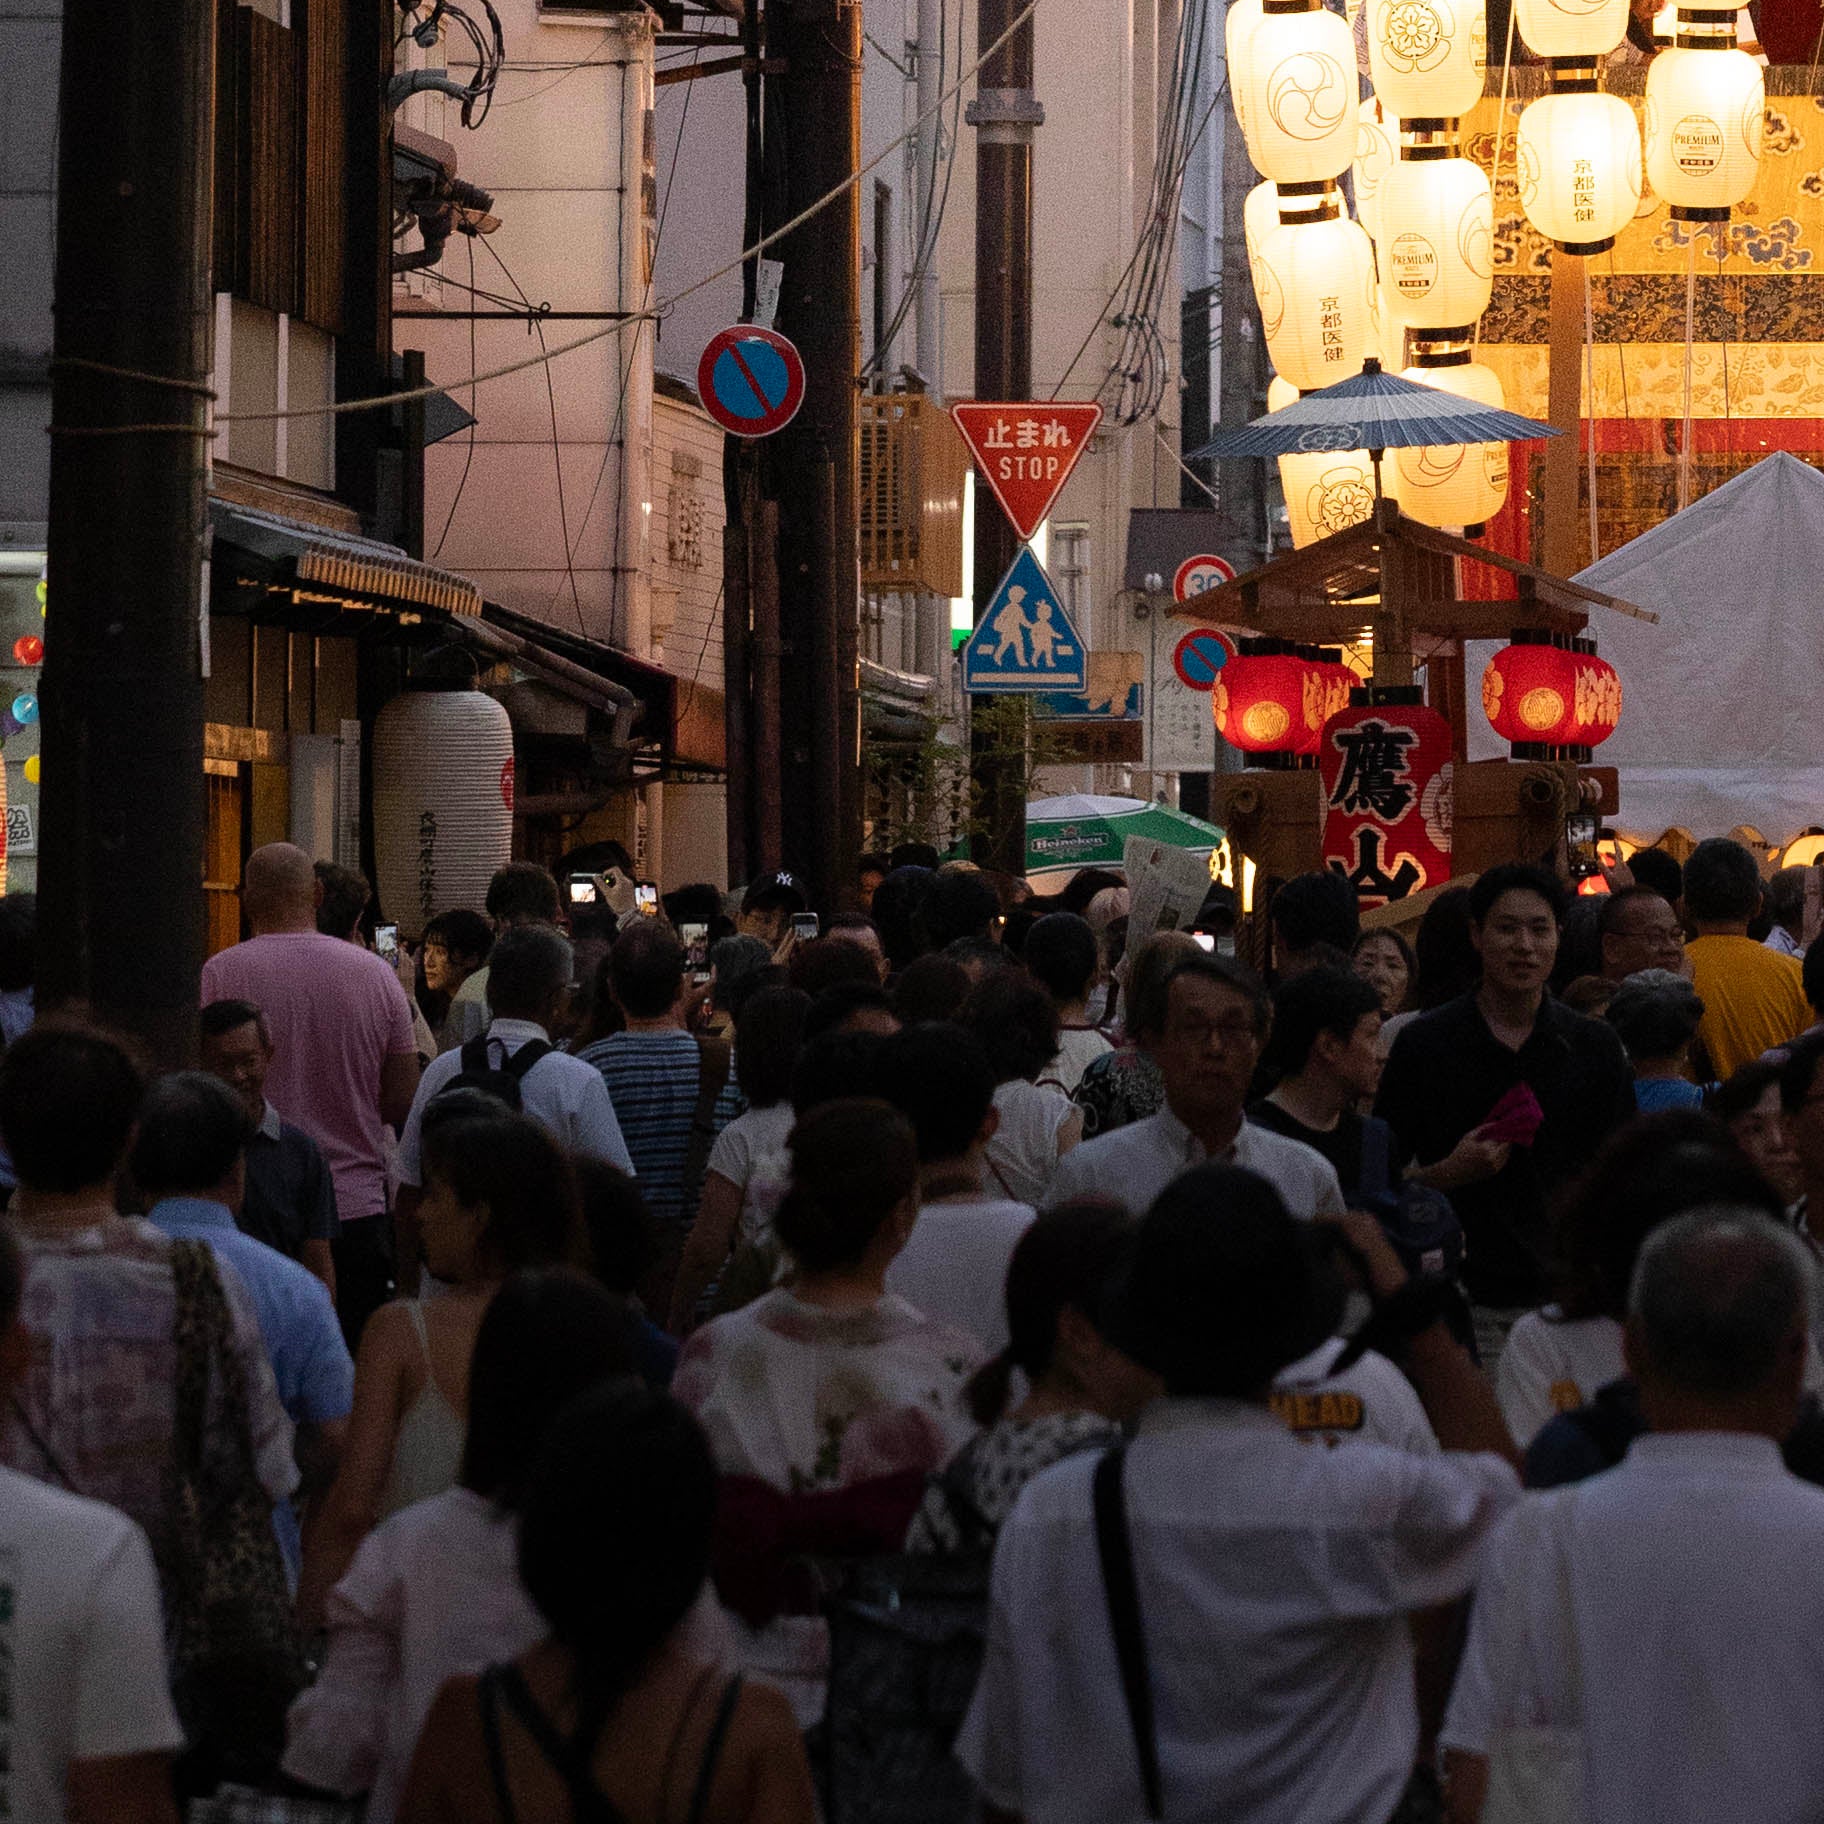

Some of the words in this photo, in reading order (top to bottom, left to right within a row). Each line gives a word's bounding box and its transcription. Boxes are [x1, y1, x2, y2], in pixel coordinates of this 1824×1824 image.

[1675, 133, 1720, 145] PREMIUM
[1573, 159, 1596, 223] 京都医健
[1392, 253, 1434, 265] PREMIUM
[1320, 296, 1345, 362] 京都医健
[984, 418, 1073, 449] 止まれ
[999, 455, 1060, 481] STOP
[1036, 835, 1103, 850] Heineken
